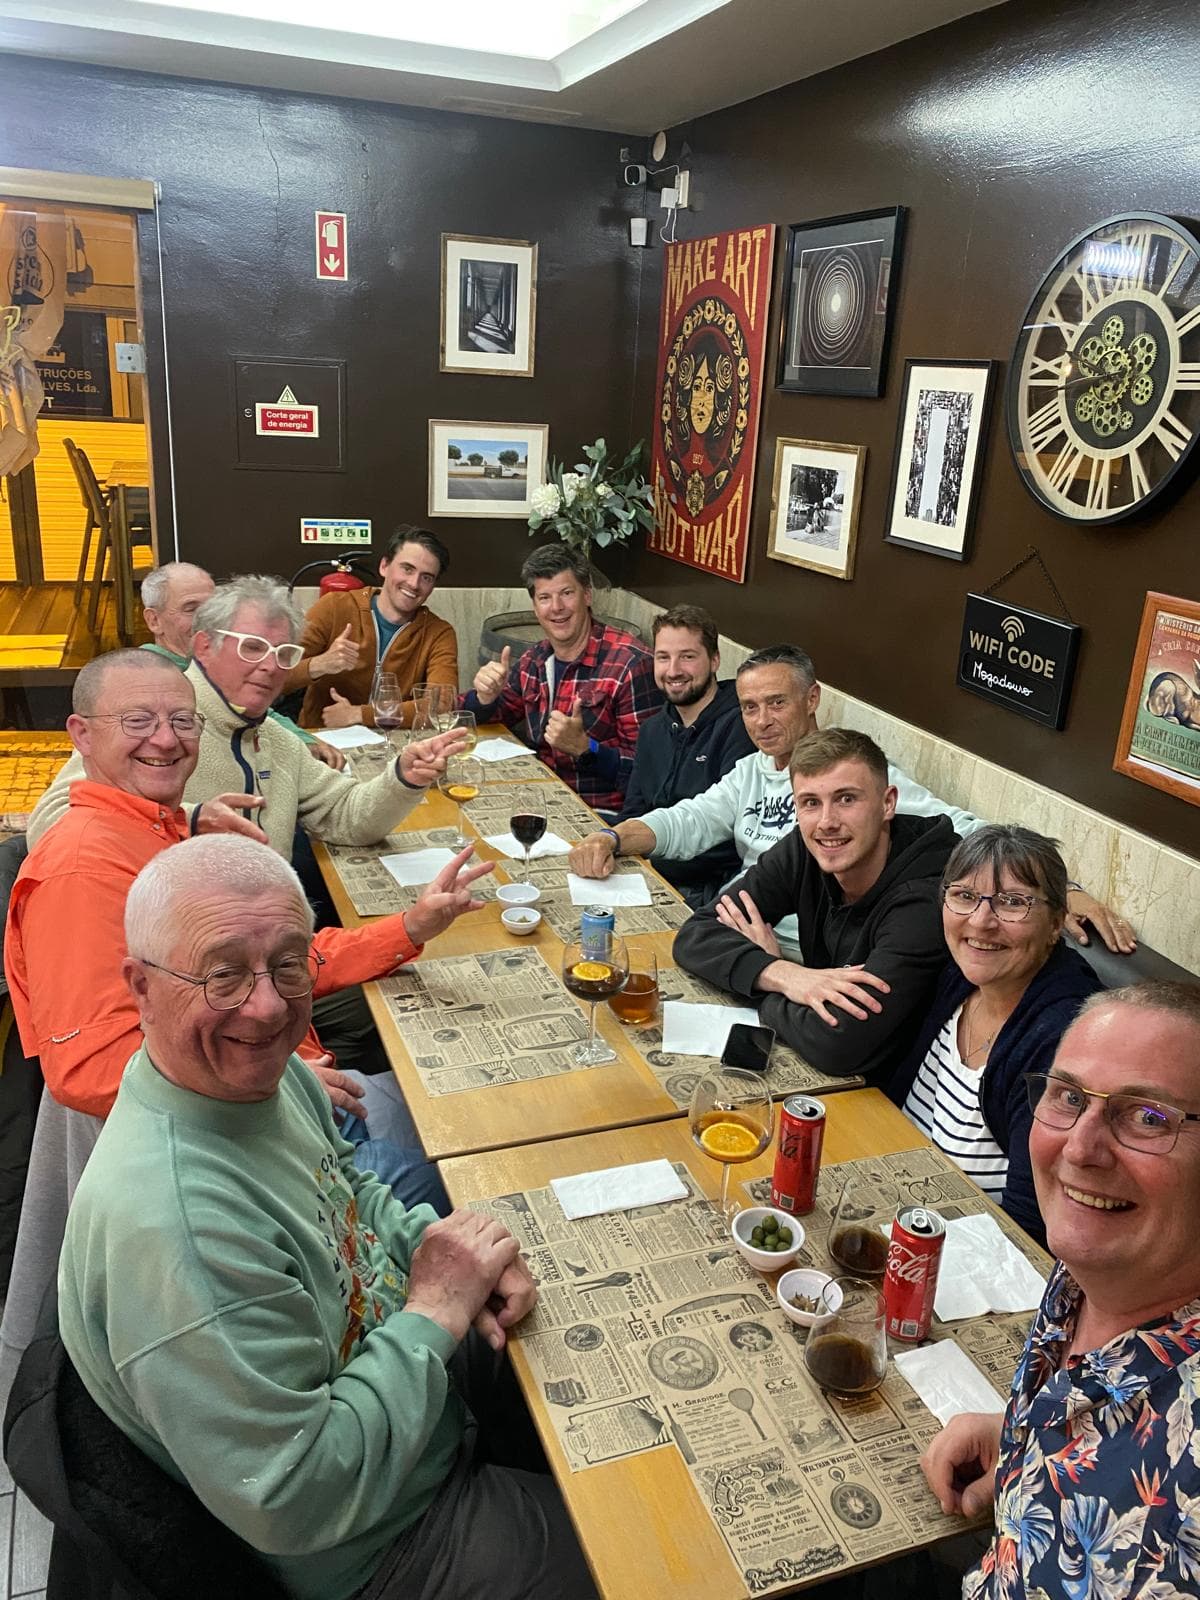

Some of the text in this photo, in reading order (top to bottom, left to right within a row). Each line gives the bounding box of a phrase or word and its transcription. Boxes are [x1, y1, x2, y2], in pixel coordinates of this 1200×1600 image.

[663, 228, 766, 346] MAKE ART
[38, 367, 92, 381] TRUÇÕES
[43, 382, 100, 393] LVES, Lda.
[289, 412, 309, 420] geral
[278, 421, 308, 430] energia
[650, 457, 744, 575] NOT WAR
[969, 630, 1056, 679] WIFI CODE
[744, 827, 779, 841] CLOTHIN
[774, 1522, 790, 1532] POST
